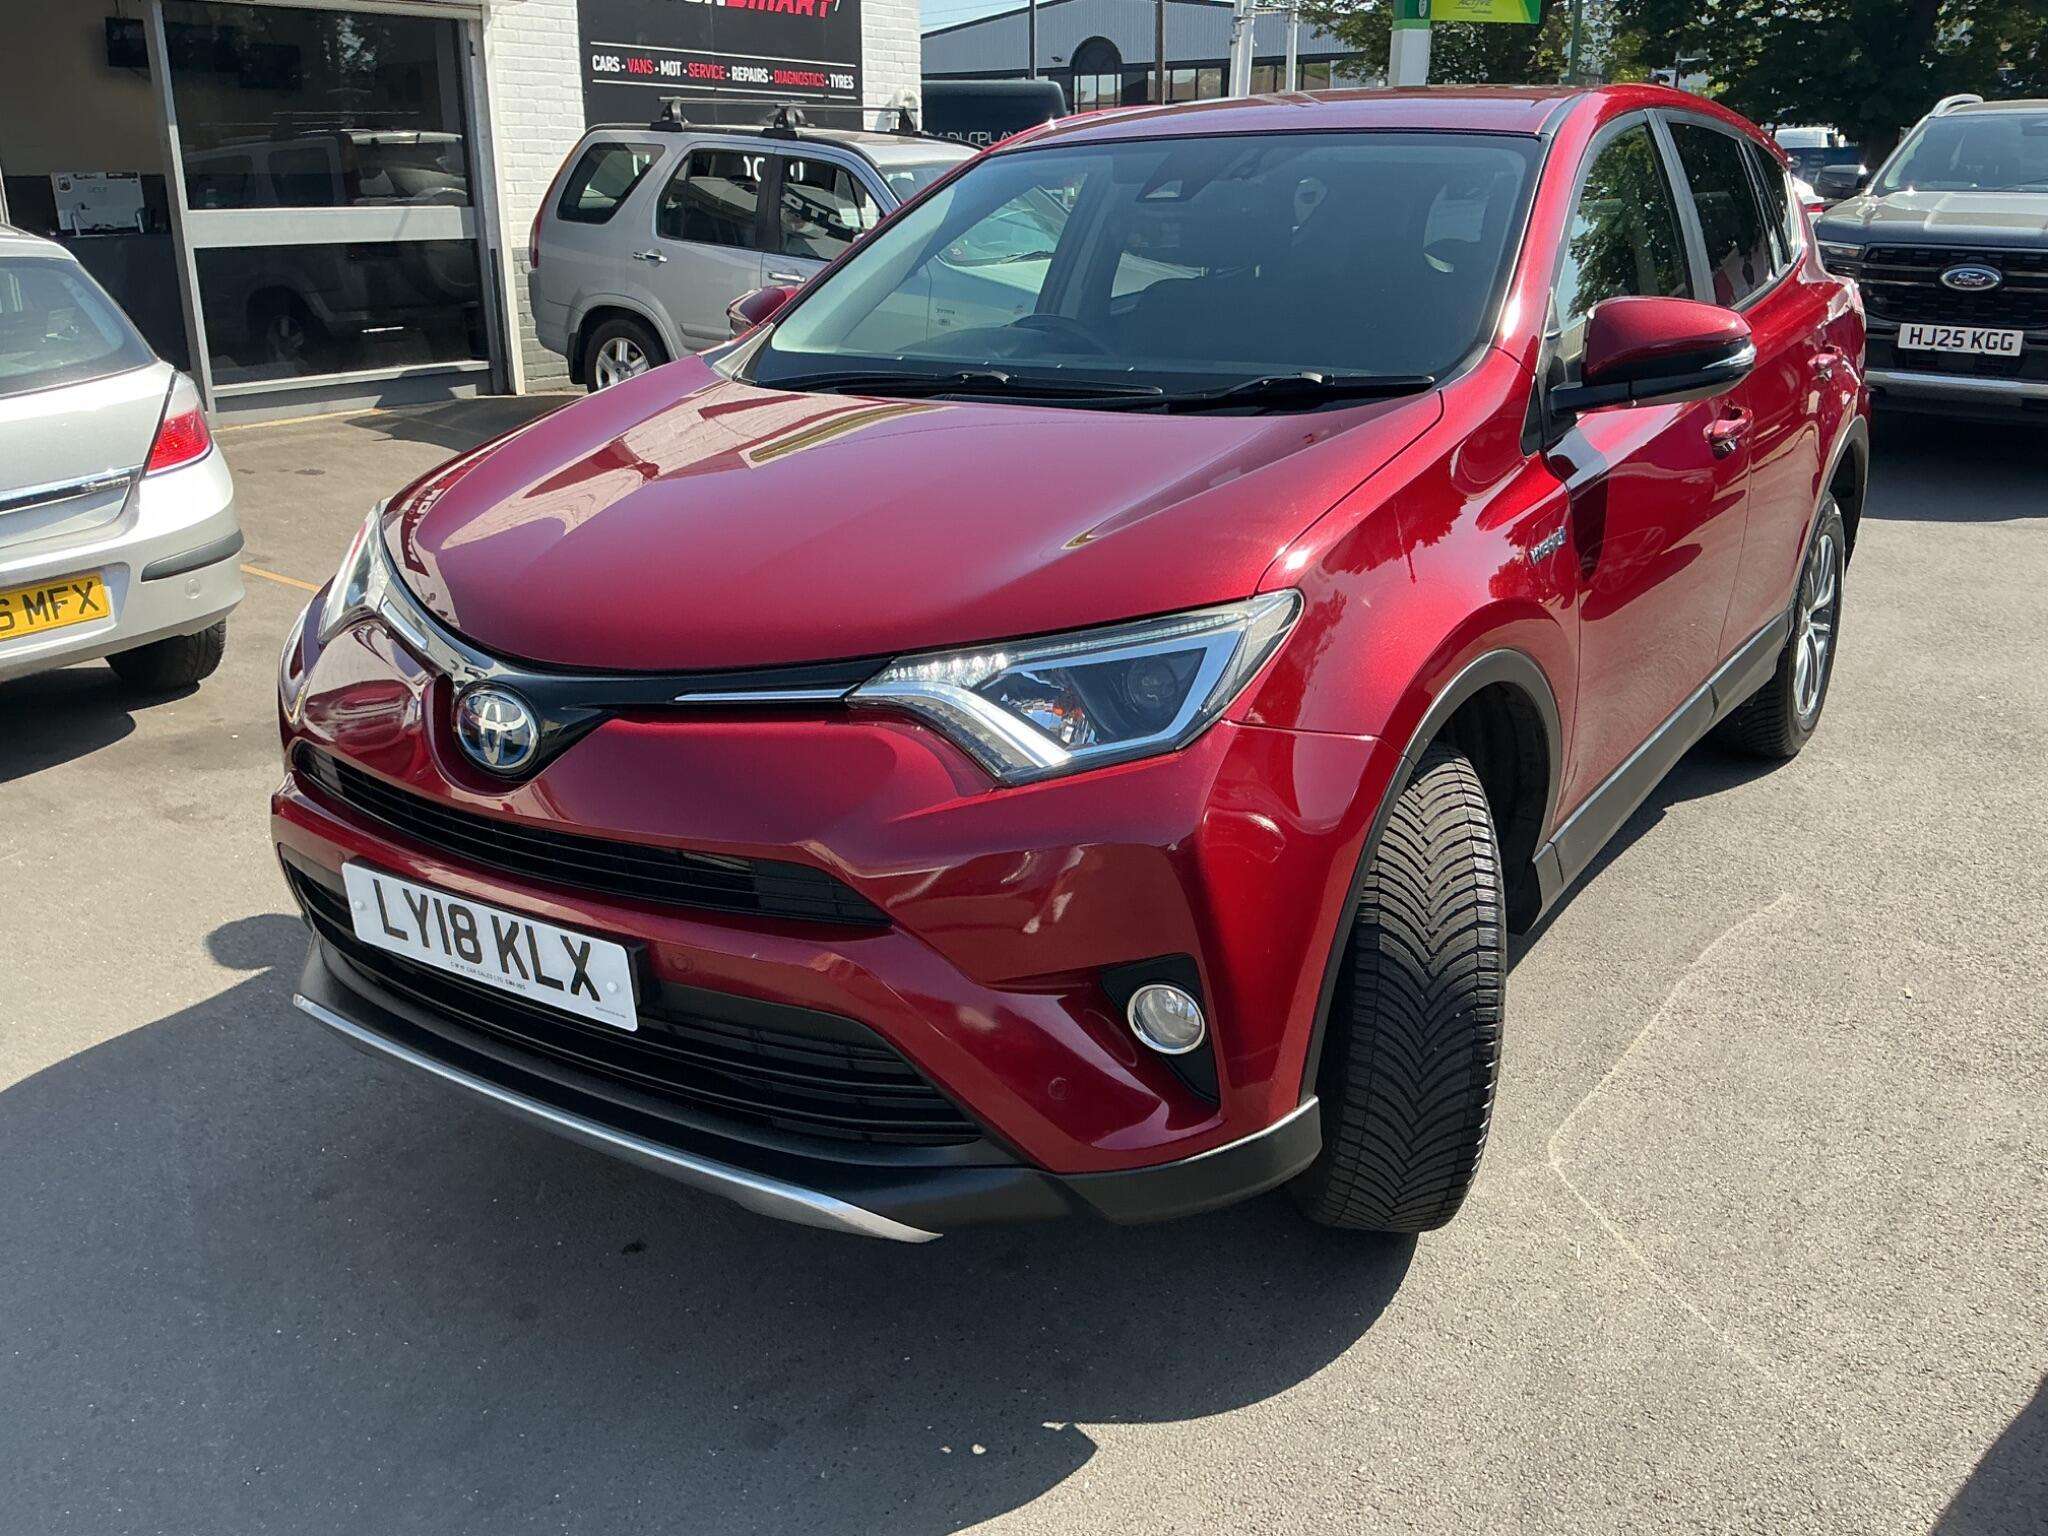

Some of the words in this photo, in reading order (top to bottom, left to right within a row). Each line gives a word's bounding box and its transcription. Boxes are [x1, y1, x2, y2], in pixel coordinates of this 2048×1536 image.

[592, 55, 620, 72] CARS
[627, 58, 654, 75] VANS
[660, 60, 682, 77] MOT
[688, 62, 726, 80] SERVICE
[731, 66, 768, 83] REPAIRS
[774, 69, 825, 87] DIAGNOSTICS
[829, 74, 854, 90] TYRES
[1954, 272, 1986, 286] Ford
[1908, 326, 1966, 348] HJ25
[1970, 330, 2015, 351] KGG
[22, 581, 100, 625] MFX
[373, 878, 482, 965] LY18
[490, 914, 601, 1003] KLX
